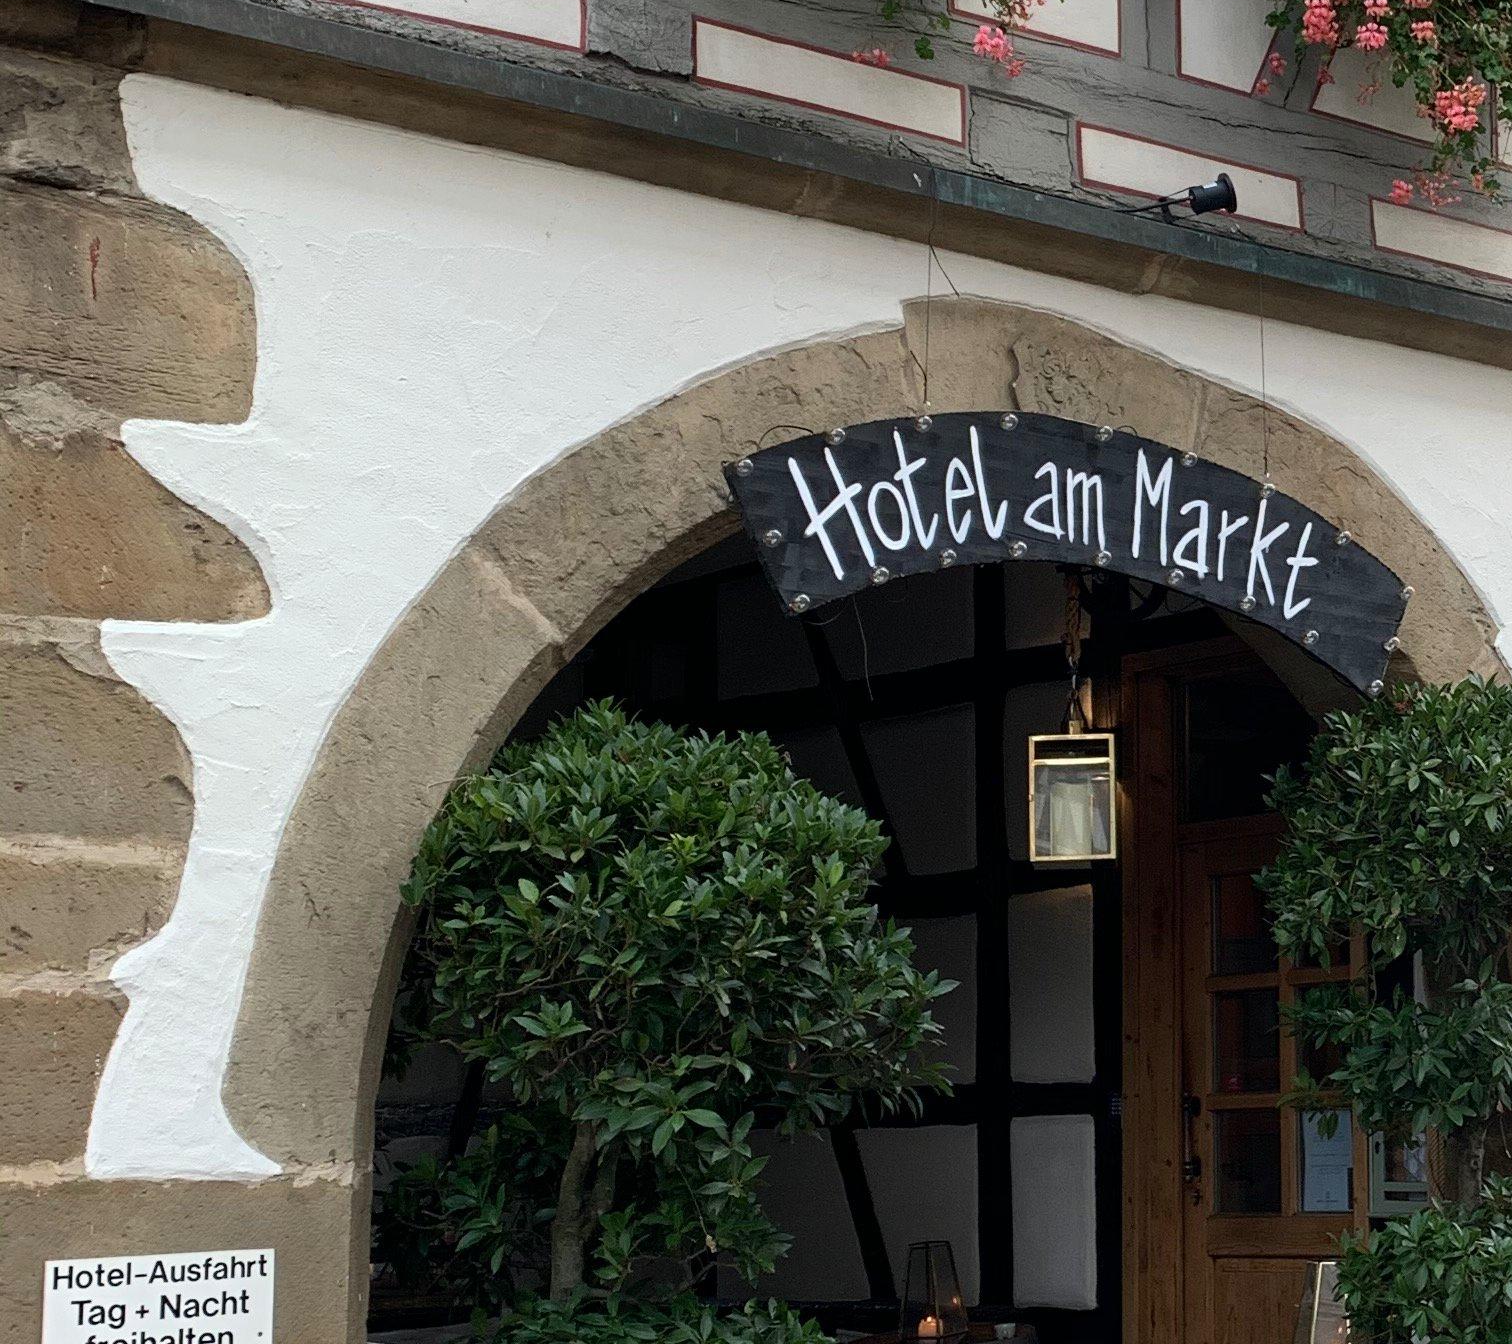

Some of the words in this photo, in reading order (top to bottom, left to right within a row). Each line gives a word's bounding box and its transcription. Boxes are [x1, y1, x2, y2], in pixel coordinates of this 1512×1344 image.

[788, 425, 1009, 581] Hotel
[1023, 460, 1106, 544] am
[1131, 447, 1320, 620] Markt
[52, 1254, 268, 1291] Hotel-Ausfahrt
[71, 1299, 127, 1329] Tag
[135, 1304, 150, 1319] +
[159, 1289, 250, 1320] Nacht
